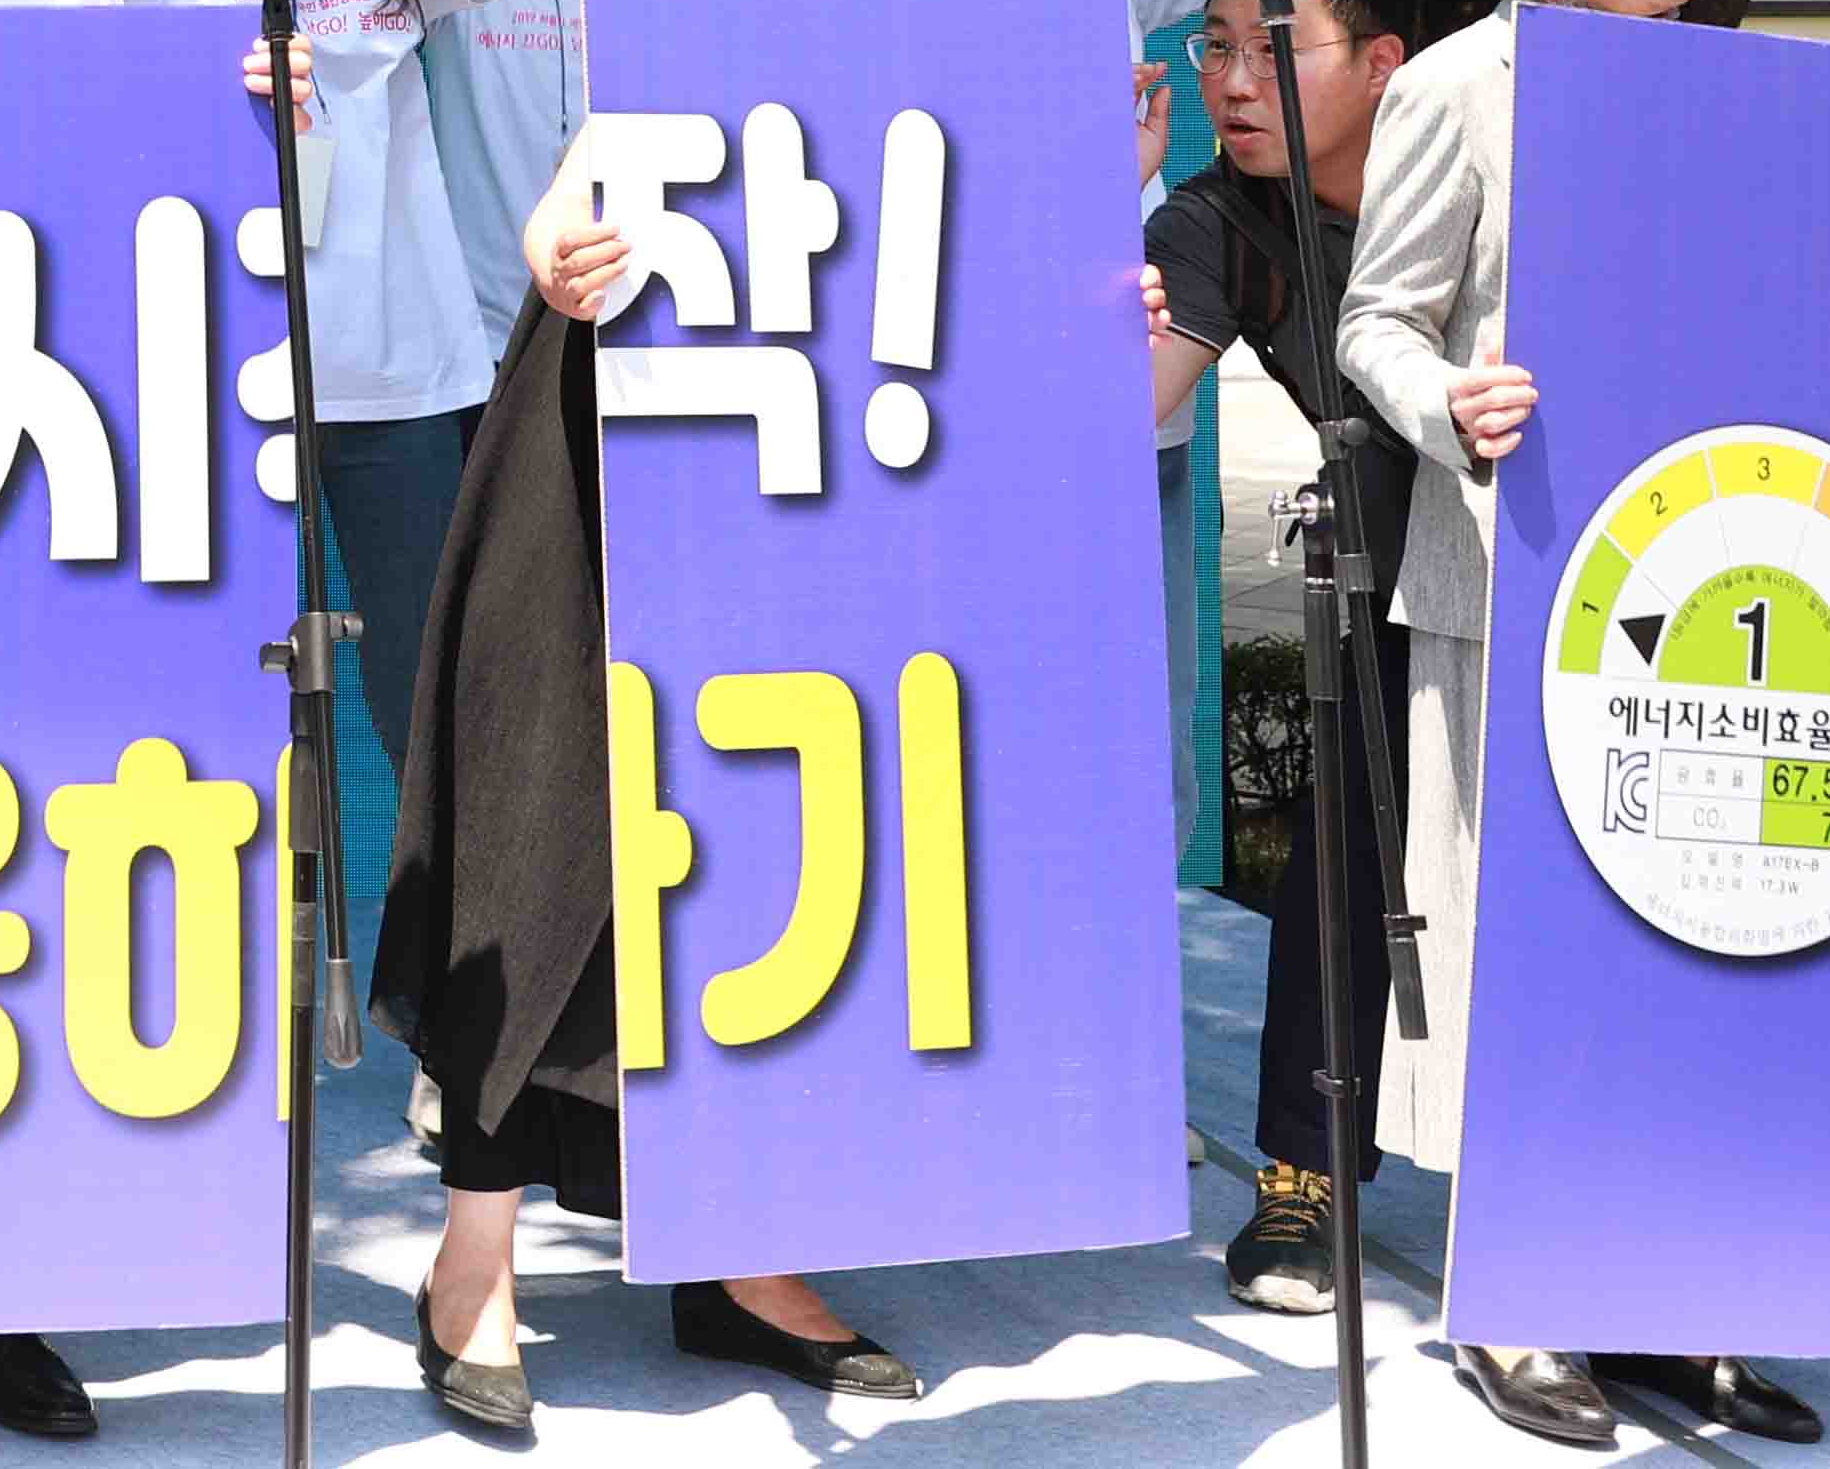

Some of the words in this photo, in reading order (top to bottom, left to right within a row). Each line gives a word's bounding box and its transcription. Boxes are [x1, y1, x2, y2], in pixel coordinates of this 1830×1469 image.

[1757, 458, 1772, 481] 3
[1650, 493, 1668, 515] 2
[1736, 599, 1768, 685] 1
